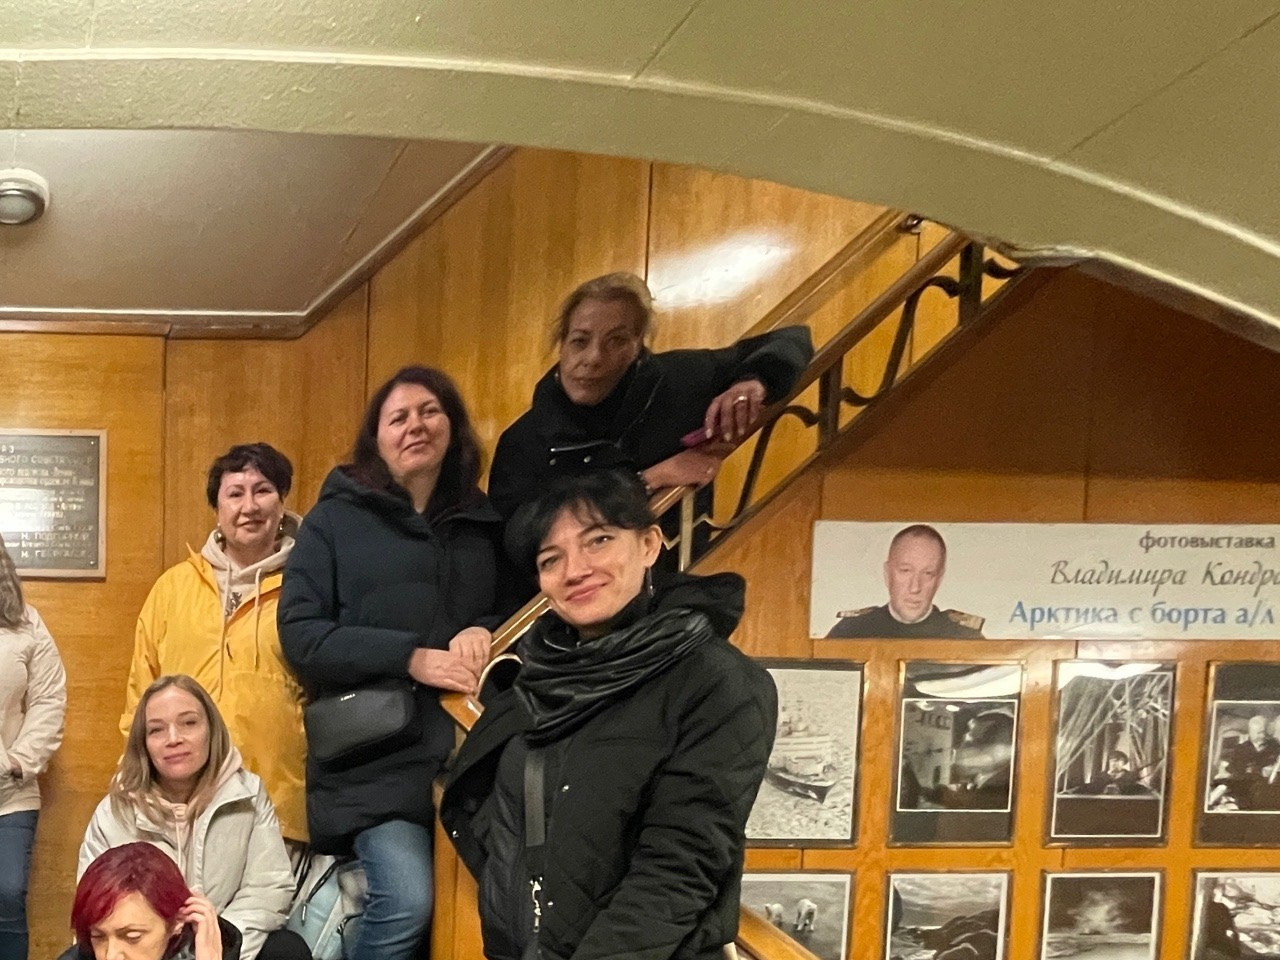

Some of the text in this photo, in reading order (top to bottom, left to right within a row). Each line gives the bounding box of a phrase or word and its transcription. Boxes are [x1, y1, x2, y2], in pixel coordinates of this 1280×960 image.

[1138, 530, 1276, 554] фотовыставка
[1050, 559, 1188, 598] Владимира
[1008, 600, 1275, 632] Арктика с борта а/л
